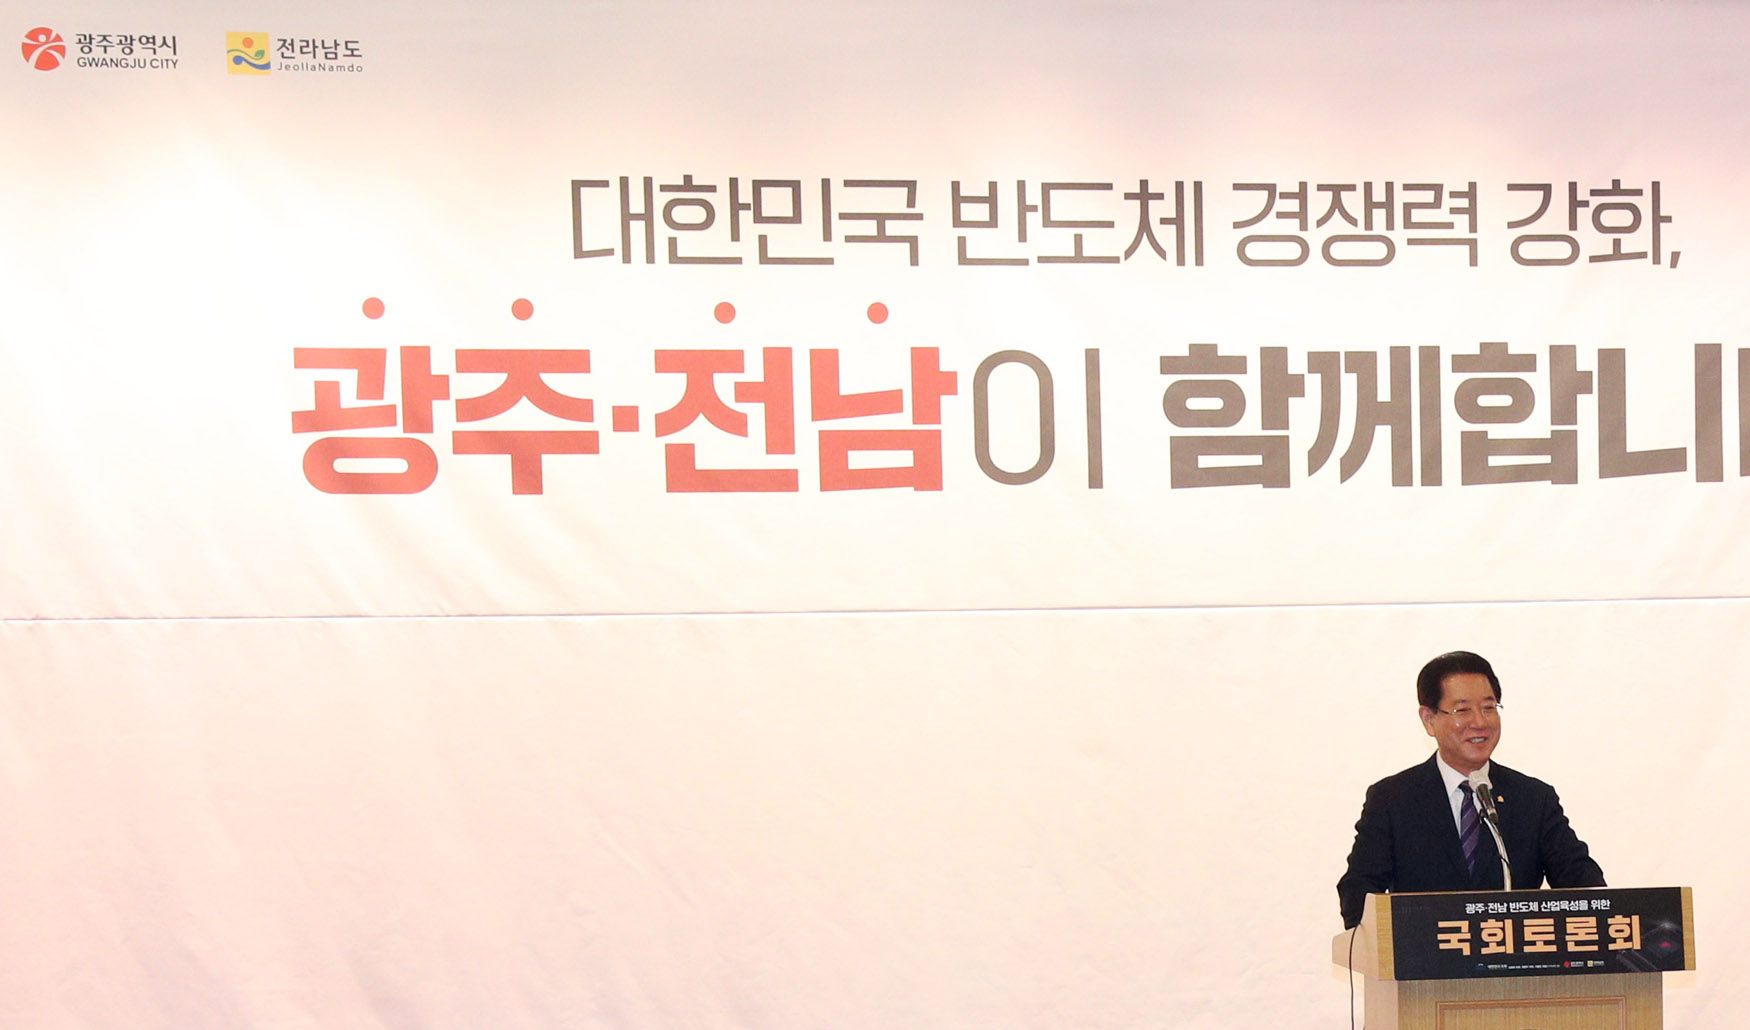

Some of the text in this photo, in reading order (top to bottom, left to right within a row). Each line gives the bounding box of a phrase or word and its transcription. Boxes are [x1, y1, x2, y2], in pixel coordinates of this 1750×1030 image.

[75, 33, 178, 56] 광주광역시
[276, 37, 363, 60] 전라남도
[77, 57, 179, 70] GWANGJU CITY
[277, 62, 364, 73] JeollaNamdo
[571, 174, 1682, 269] 대한민국 반도체 경쟁력 강화,
[291, 344, 1104, 495] 광주·전남이
[1465, 899, 1611, 915] 광주·전남 반도체 산업육성을 위한
[1437, 914, 1642, 956] 국회토론회
